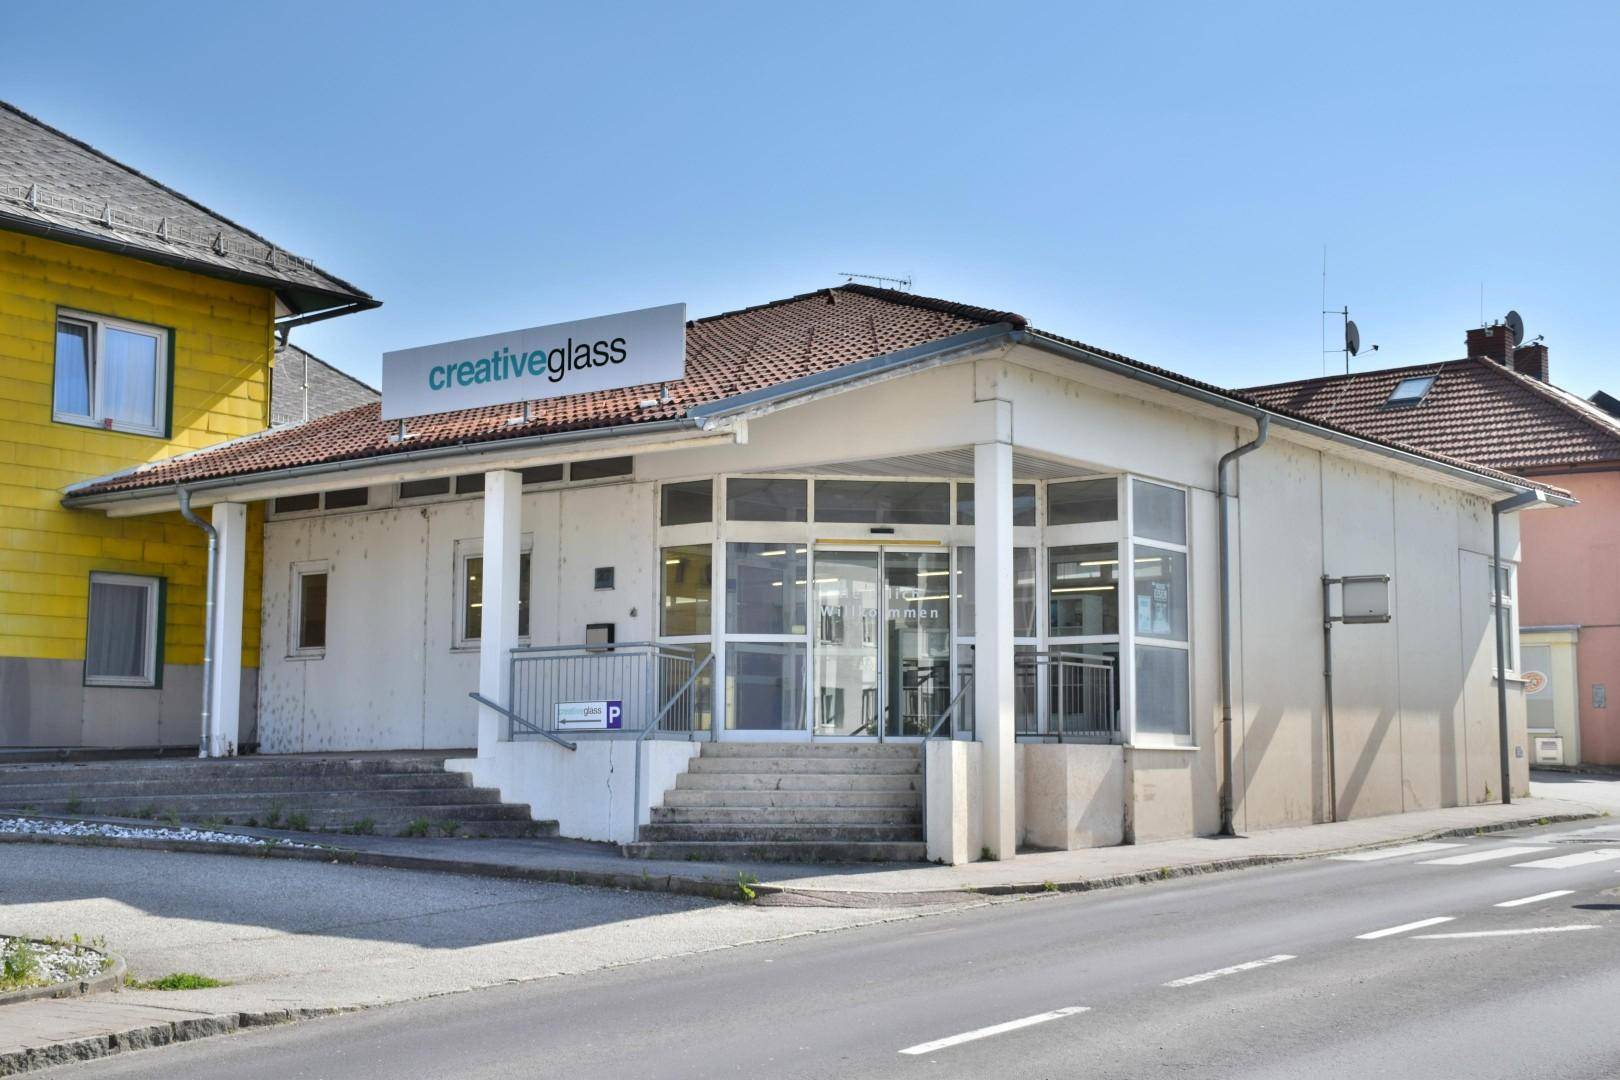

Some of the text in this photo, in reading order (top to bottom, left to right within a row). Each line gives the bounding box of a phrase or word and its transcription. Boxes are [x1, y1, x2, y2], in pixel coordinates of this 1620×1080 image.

[428, 337, 627, 391] creativeglass
[820, 605, 939, 619] Willkommen
[609, 706, 621, 724] P
